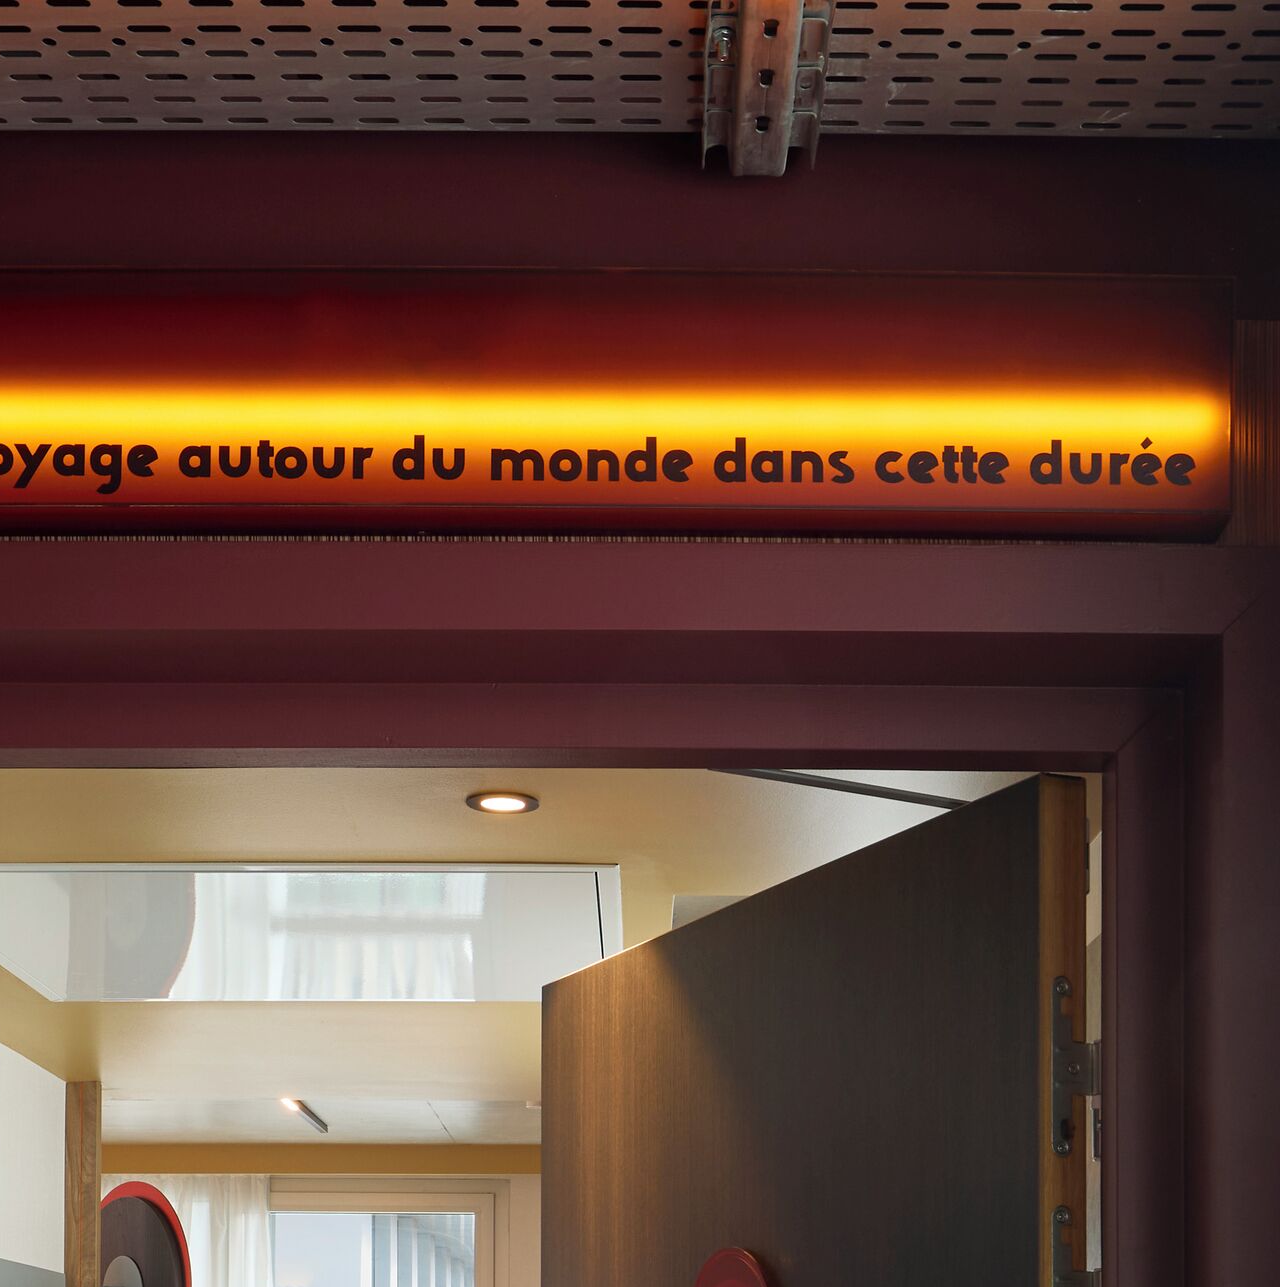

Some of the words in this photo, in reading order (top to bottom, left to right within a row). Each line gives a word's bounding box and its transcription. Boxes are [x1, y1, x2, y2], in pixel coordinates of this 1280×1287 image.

[178, 439, 374, 480] autour
[392, 434, 466, 481] du
[490, 436, 694, 482] monde
[713, 437, 855, 484] dans
[875, 445, 1009, 485] cette
[1029, 437, 1196, 487] durée
